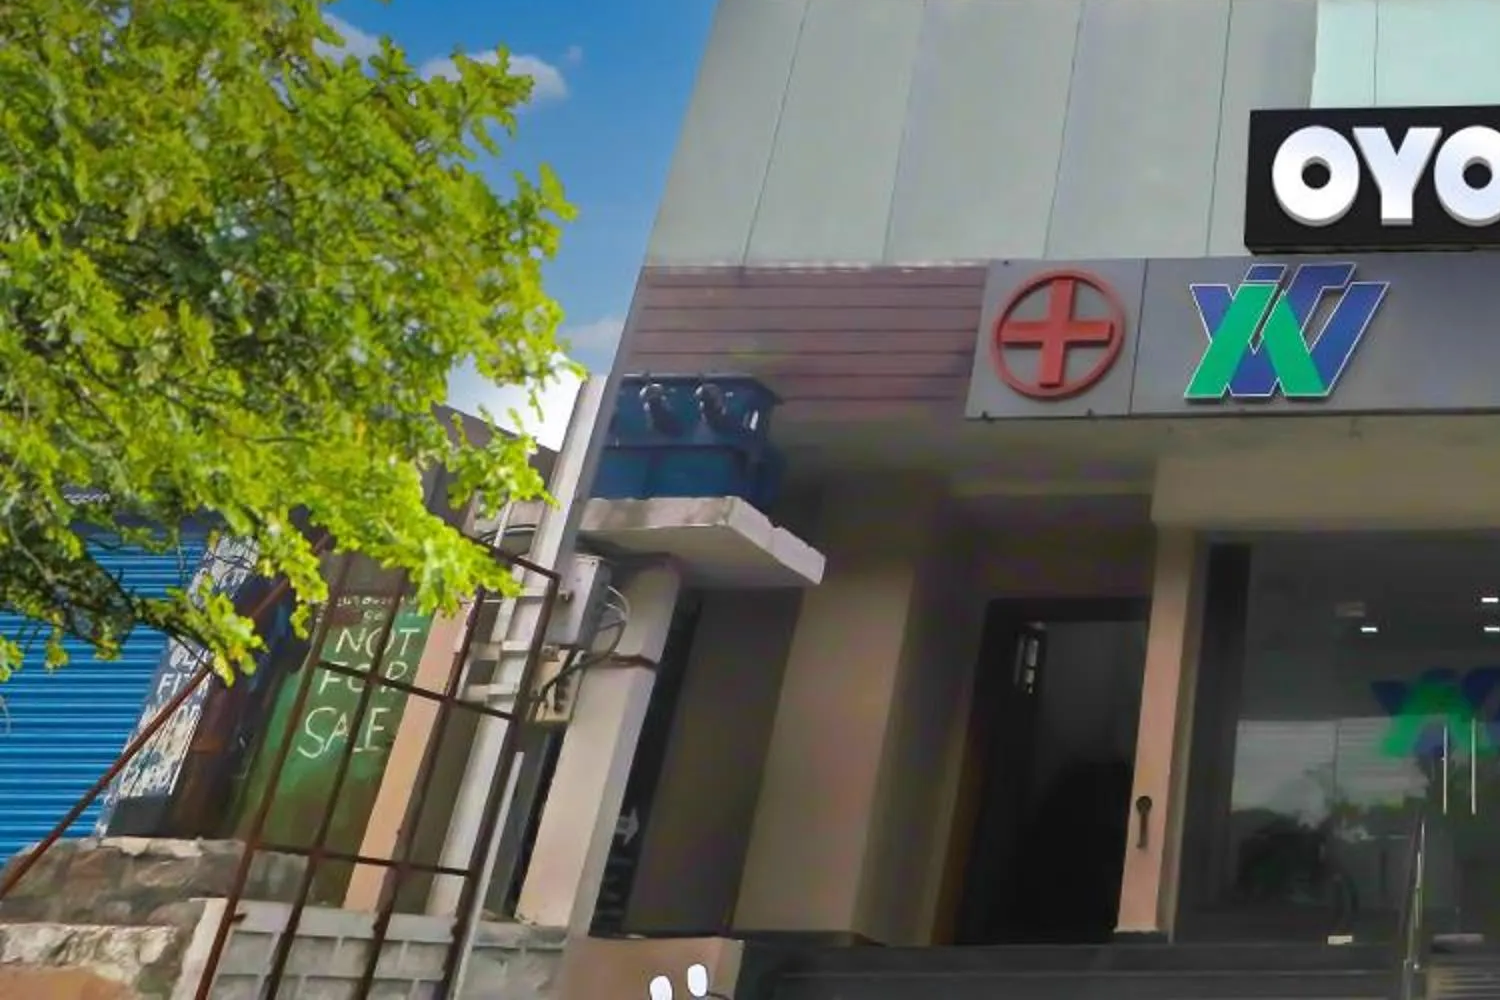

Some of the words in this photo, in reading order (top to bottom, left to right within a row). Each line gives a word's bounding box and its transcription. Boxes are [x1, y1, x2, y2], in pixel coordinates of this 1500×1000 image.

[335, 626, 421, 658] NOT
[318, 660, 408, 695] FOR
[297, 706, 391, 760] SAE
